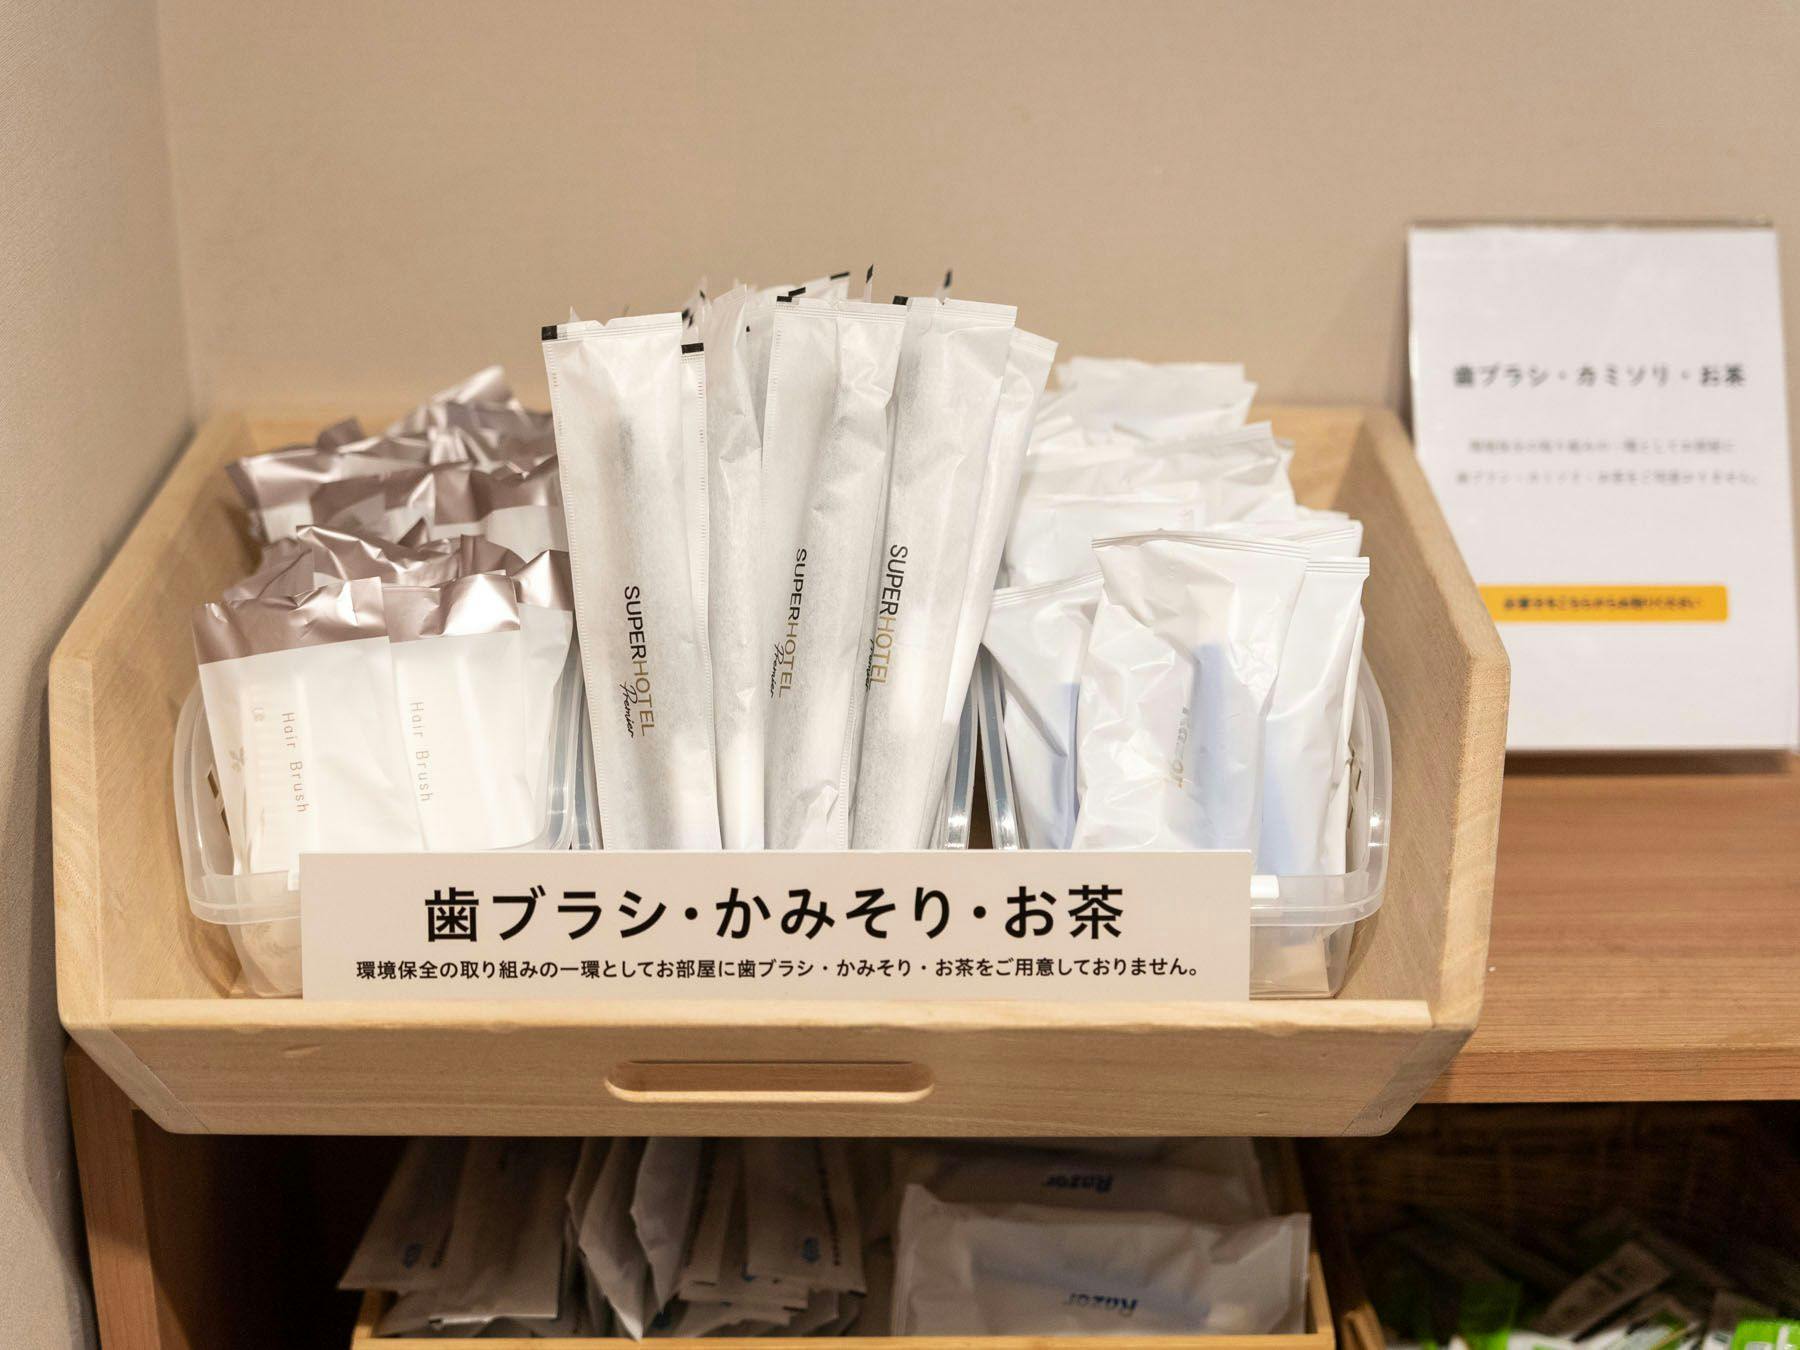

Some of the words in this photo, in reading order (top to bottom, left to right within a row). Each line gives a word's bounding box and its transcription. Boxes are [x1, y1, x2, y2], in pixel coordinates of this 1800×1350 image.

[778, 548, 808, 698] SUPERHOTEL
[869, 544, 909, 686] SUPERHOTEL
[623, 585, 655, 737] SUPERHOTEL
[769, 642, 785, 699] Premier
[410, 701, 425, 738] Hair
[618, 681, 638, 739] Premier
[281, 712, 297, 749] Hair
[289, 760, 309, 813] Brush
[415, 750, 433, 803] Brush
[424, 884, 1124, 943] 歯ブラシ・かみそり・お茶
[355, 956, 1198, 980] 環境保全の取り組みの一環としてお部屋に歯ブラシ・かみそり・お茶をご用意しておりません。
